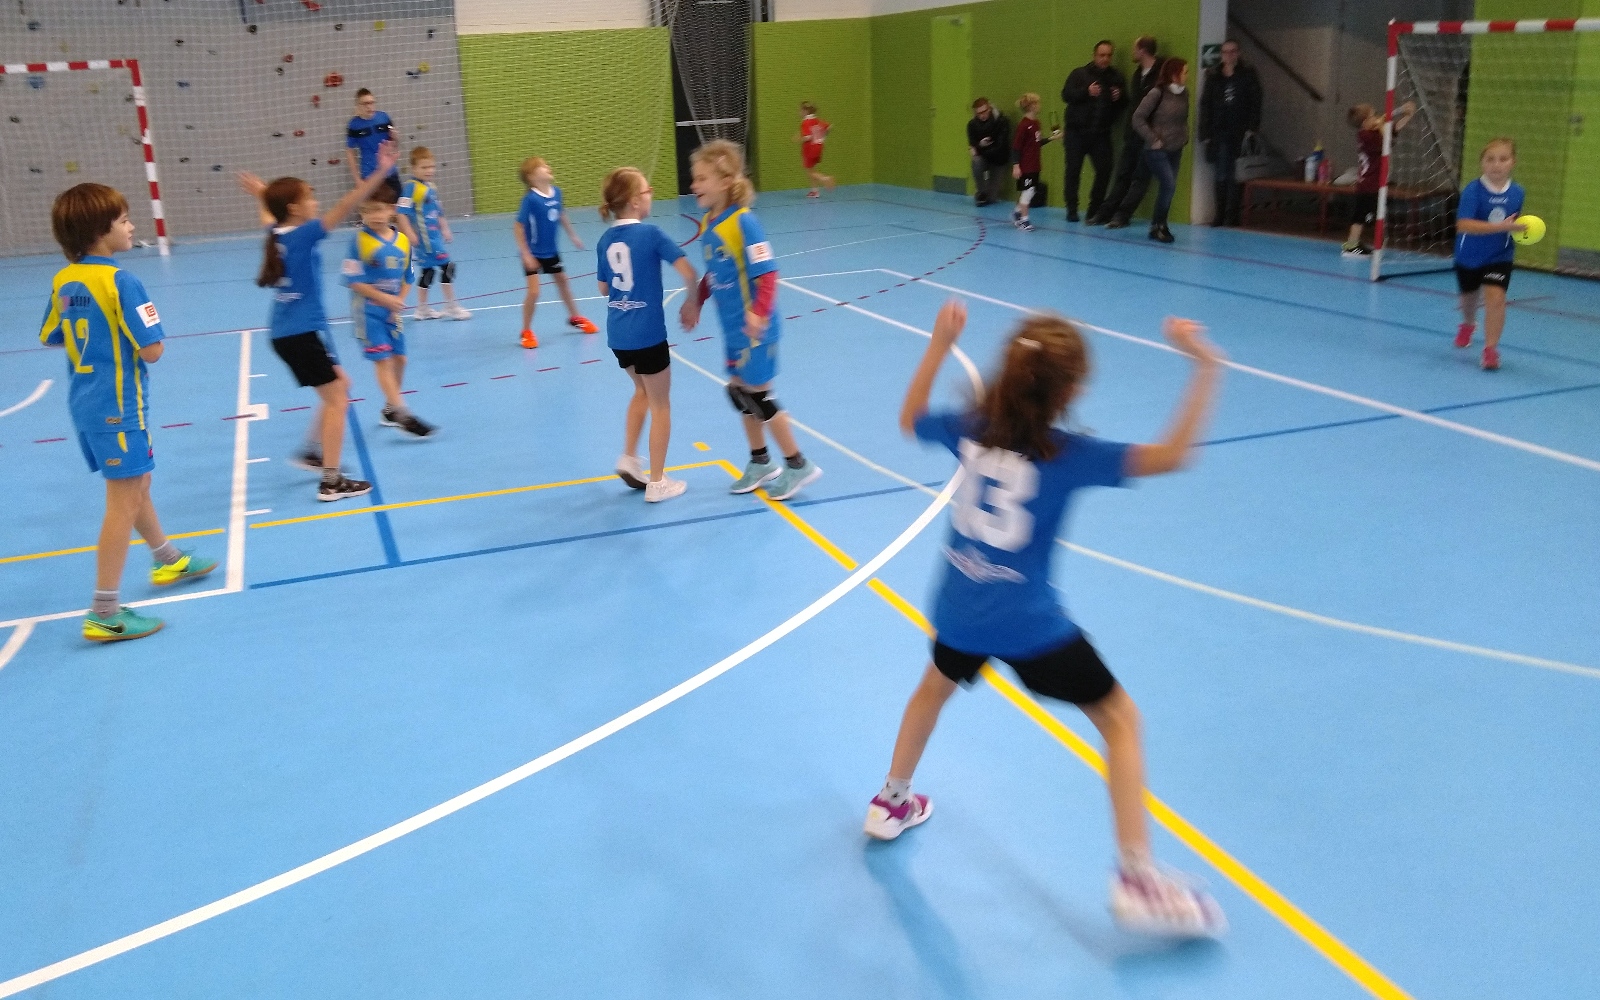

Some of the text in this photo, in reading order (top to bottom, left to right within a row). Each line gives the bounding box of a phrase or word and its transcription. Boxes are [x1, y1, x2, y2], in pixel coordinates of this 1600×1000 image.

[606, 241, 634, 292] 9
[61, 318, 94, 374] 12
[951, 436, 1041, 553] 13
